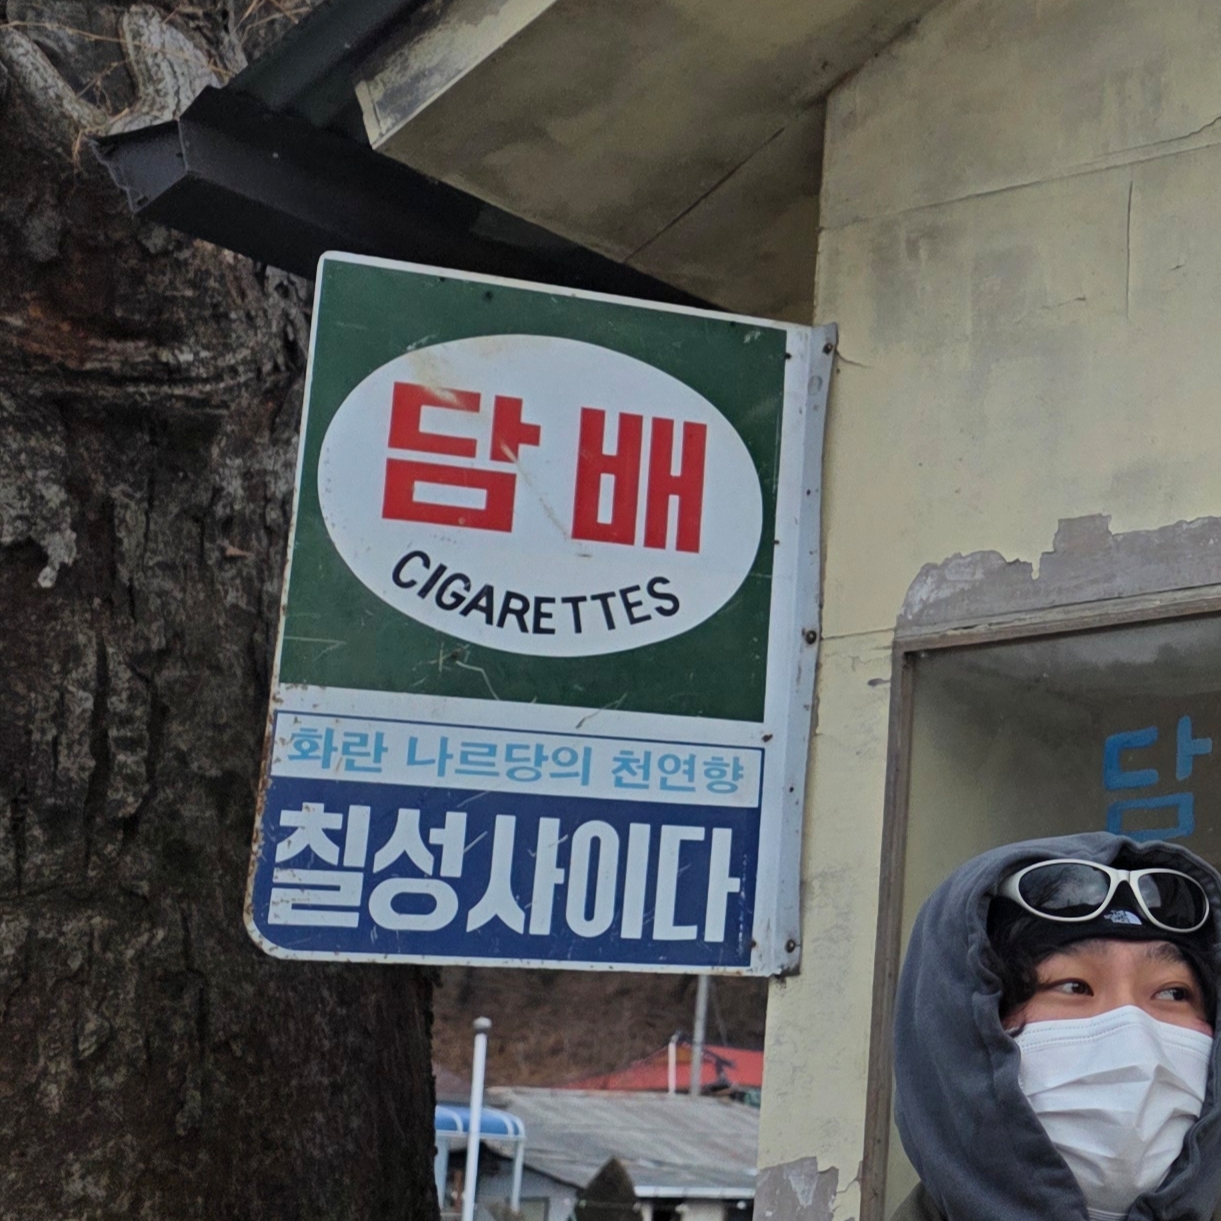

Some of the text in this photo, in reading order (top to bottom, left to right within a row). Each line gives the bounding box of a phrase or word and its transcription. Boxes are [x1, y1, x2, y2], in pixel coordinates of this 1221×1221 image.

[391, 550, 680, 635] CIGARETTES
[287, 727, 745, 795] 화란 나르당의 천연향
[268, 801, 742, 943] 칠성사이다
